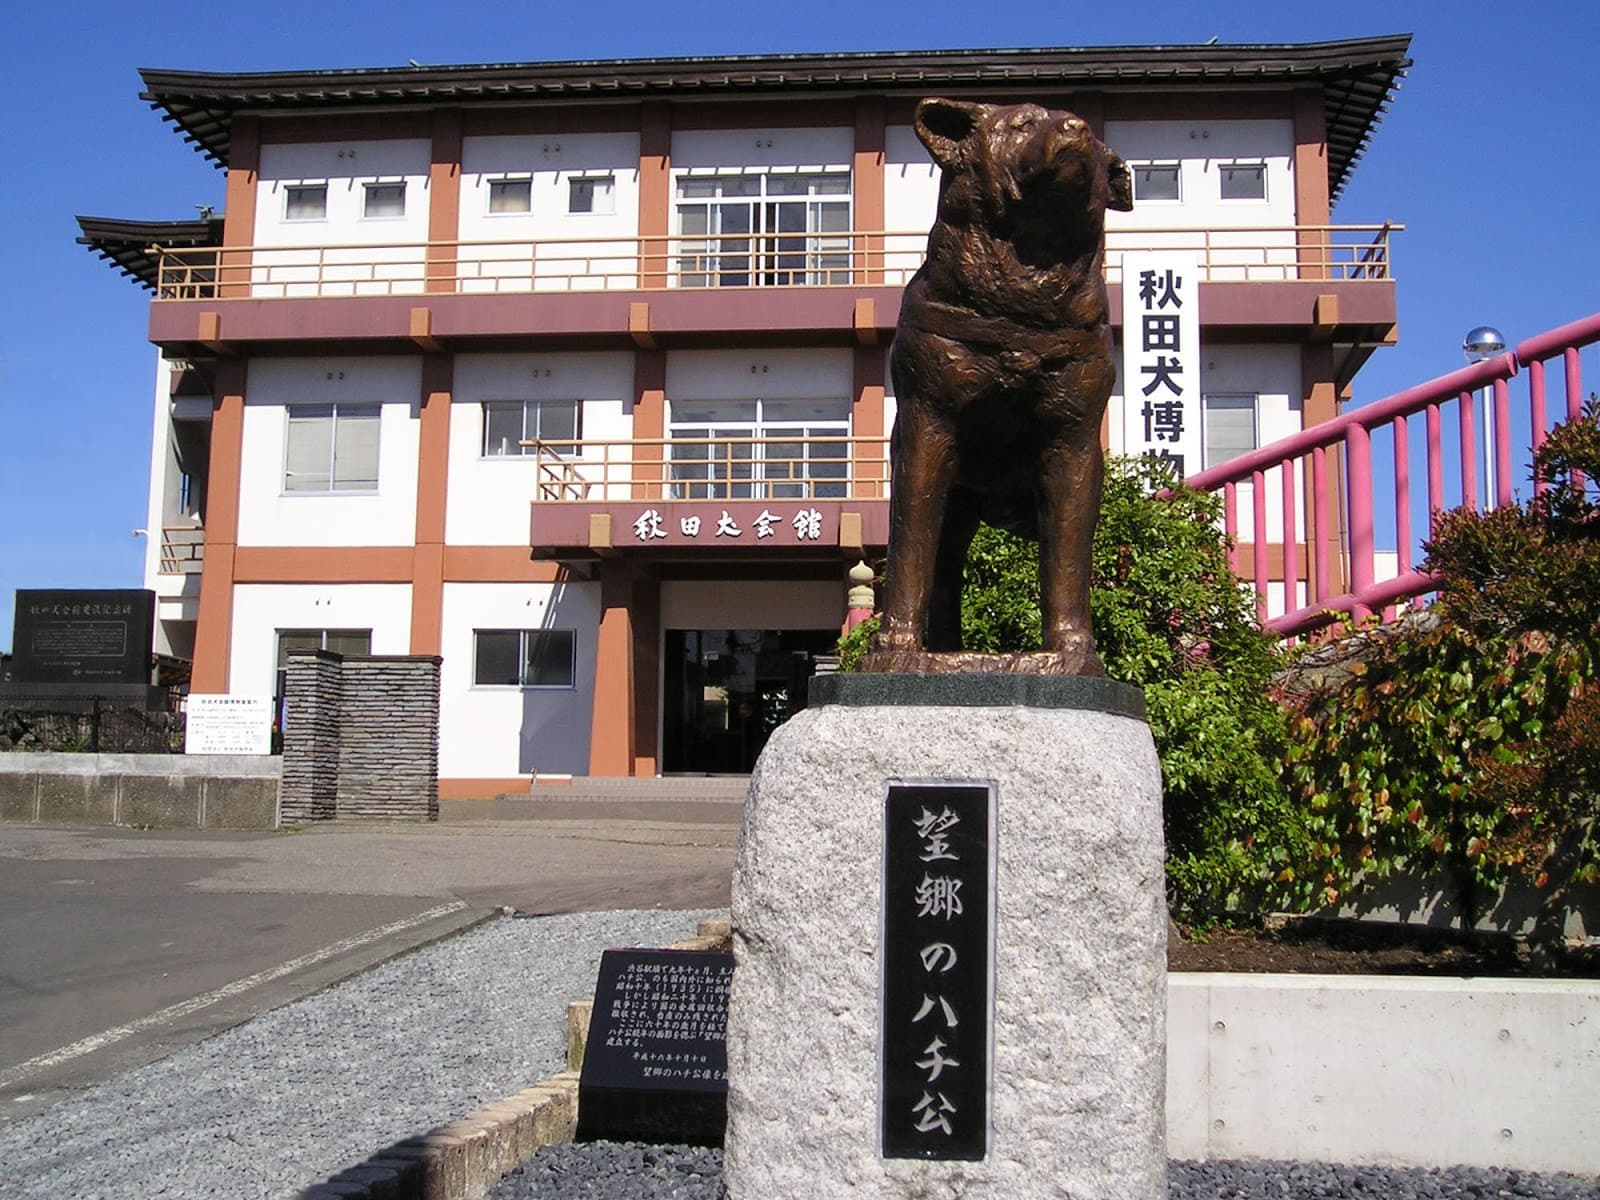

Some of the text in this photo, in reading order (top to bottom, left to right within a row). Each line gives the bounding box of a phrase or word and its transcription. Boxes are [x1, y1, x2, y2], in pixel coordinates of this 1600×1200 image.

[633, 507, 823, 541] 秋田犬会館
[911, 804, 965, 1136] 望郷のハチ公
